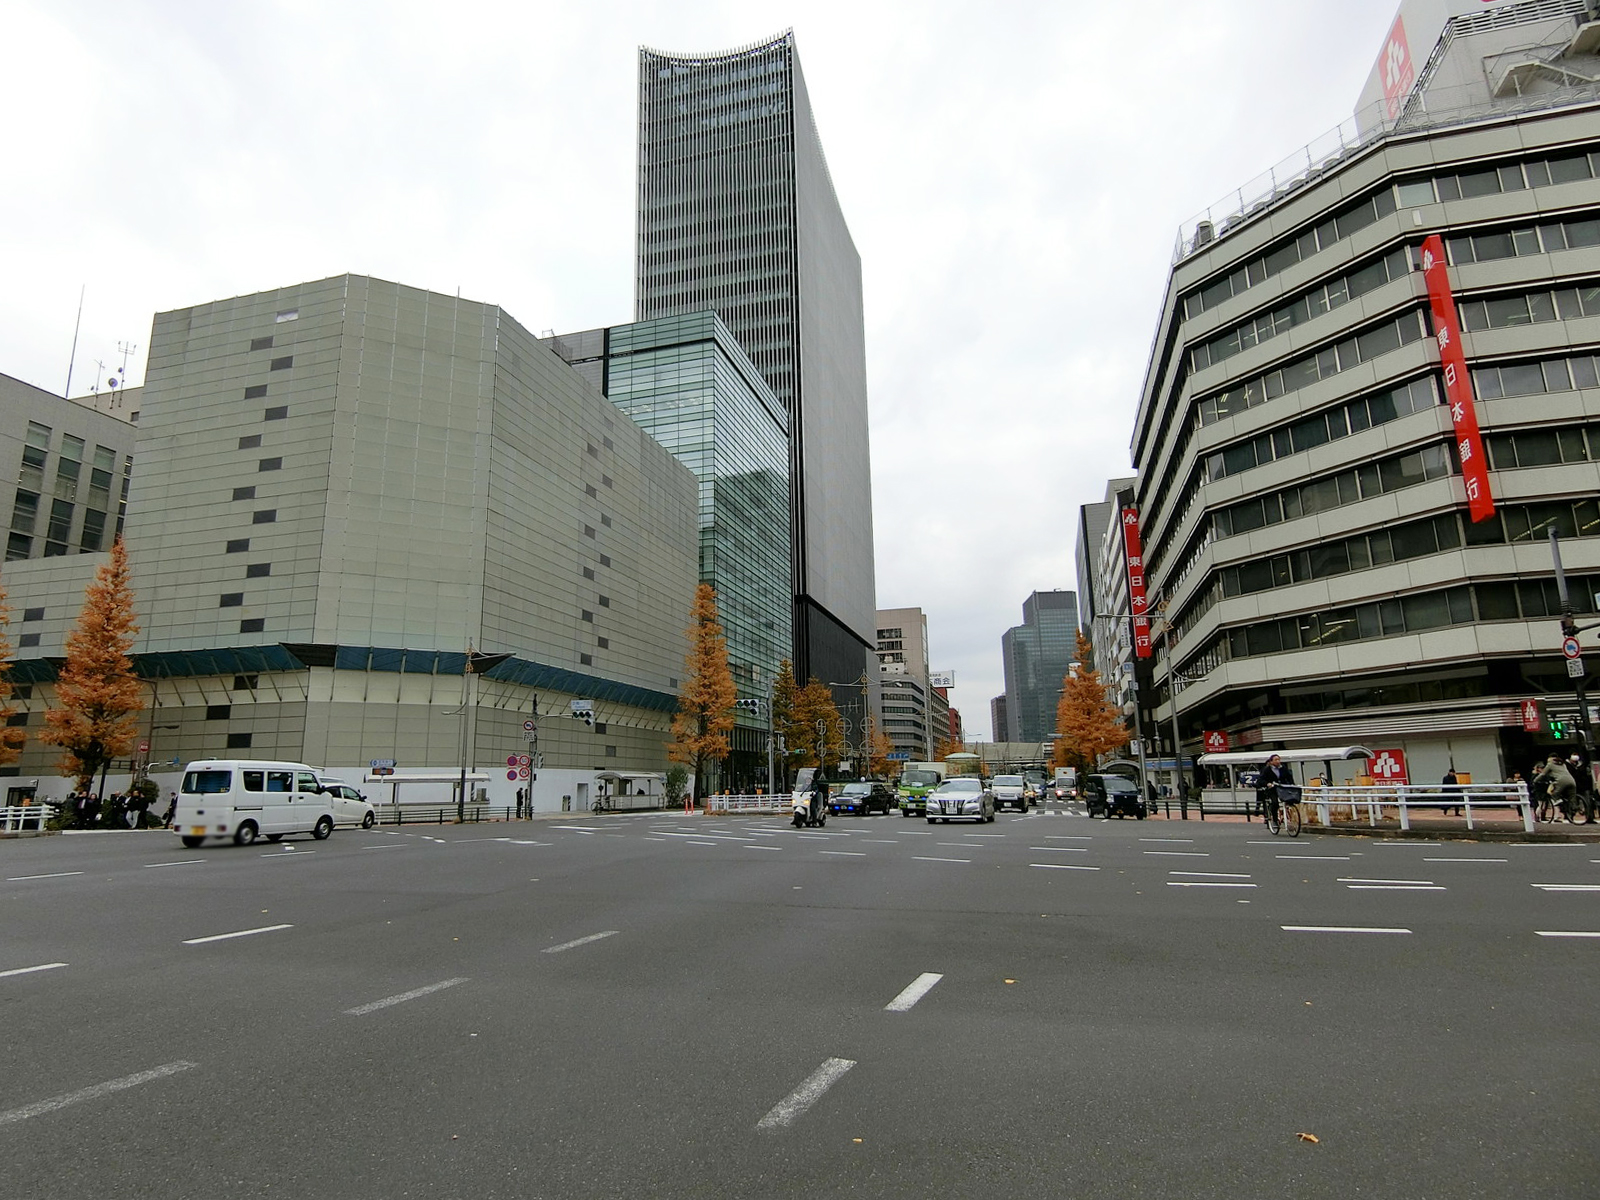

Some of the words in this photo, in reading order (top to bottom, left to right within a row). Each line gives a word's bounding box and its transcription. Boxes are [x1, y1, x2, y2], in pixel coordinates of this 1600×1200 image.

[1437, 326, 1479, 501] 東日本銀行
[1128, 556, 1149, 646] 東日本銀行
